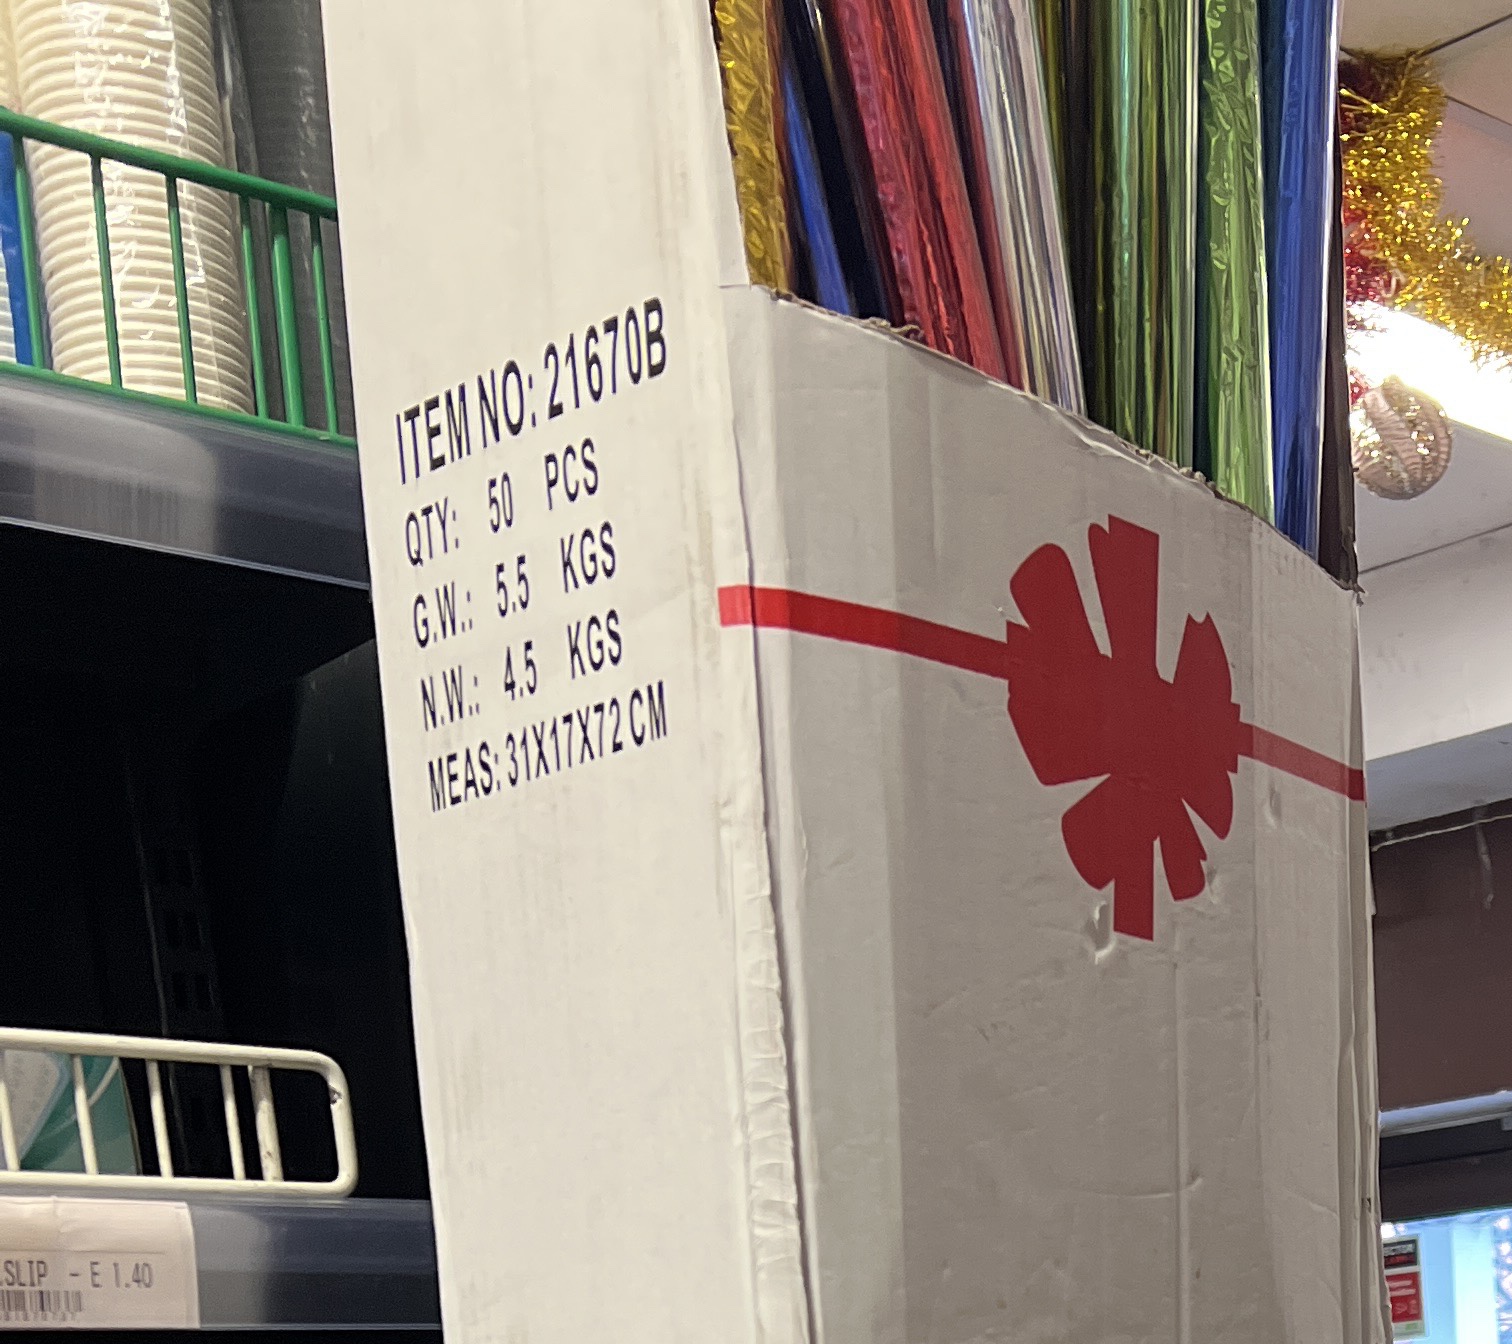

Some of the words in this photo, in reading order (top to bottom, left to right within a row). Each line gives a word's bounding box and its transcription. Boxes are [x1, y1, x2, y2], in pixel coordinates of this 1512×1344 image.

[396, 383, 471, 484] ITEM
[477, 360, 536, 450] NO:
[545, 297, 666, 421] 21670B
[406, 497, 460, 566] QTY:
[488, 472, 513, 533] 50
[545, 437, 599, 510] PCS
[413, 581, 473, 648] G.W.:
[496, 554, 530, 618] 5.5
[561, 521, 617, 593] KGS
[421, 665, 480, 731] N.W.:
[504, 641, 537, 702] 4.5
[568, 609, 623, 680] KGS
[0, 1261, 47, 1288] .SLIP
[90, 1262, 102, 1288] E
[112, 1263, 154, 1288] 1.40
